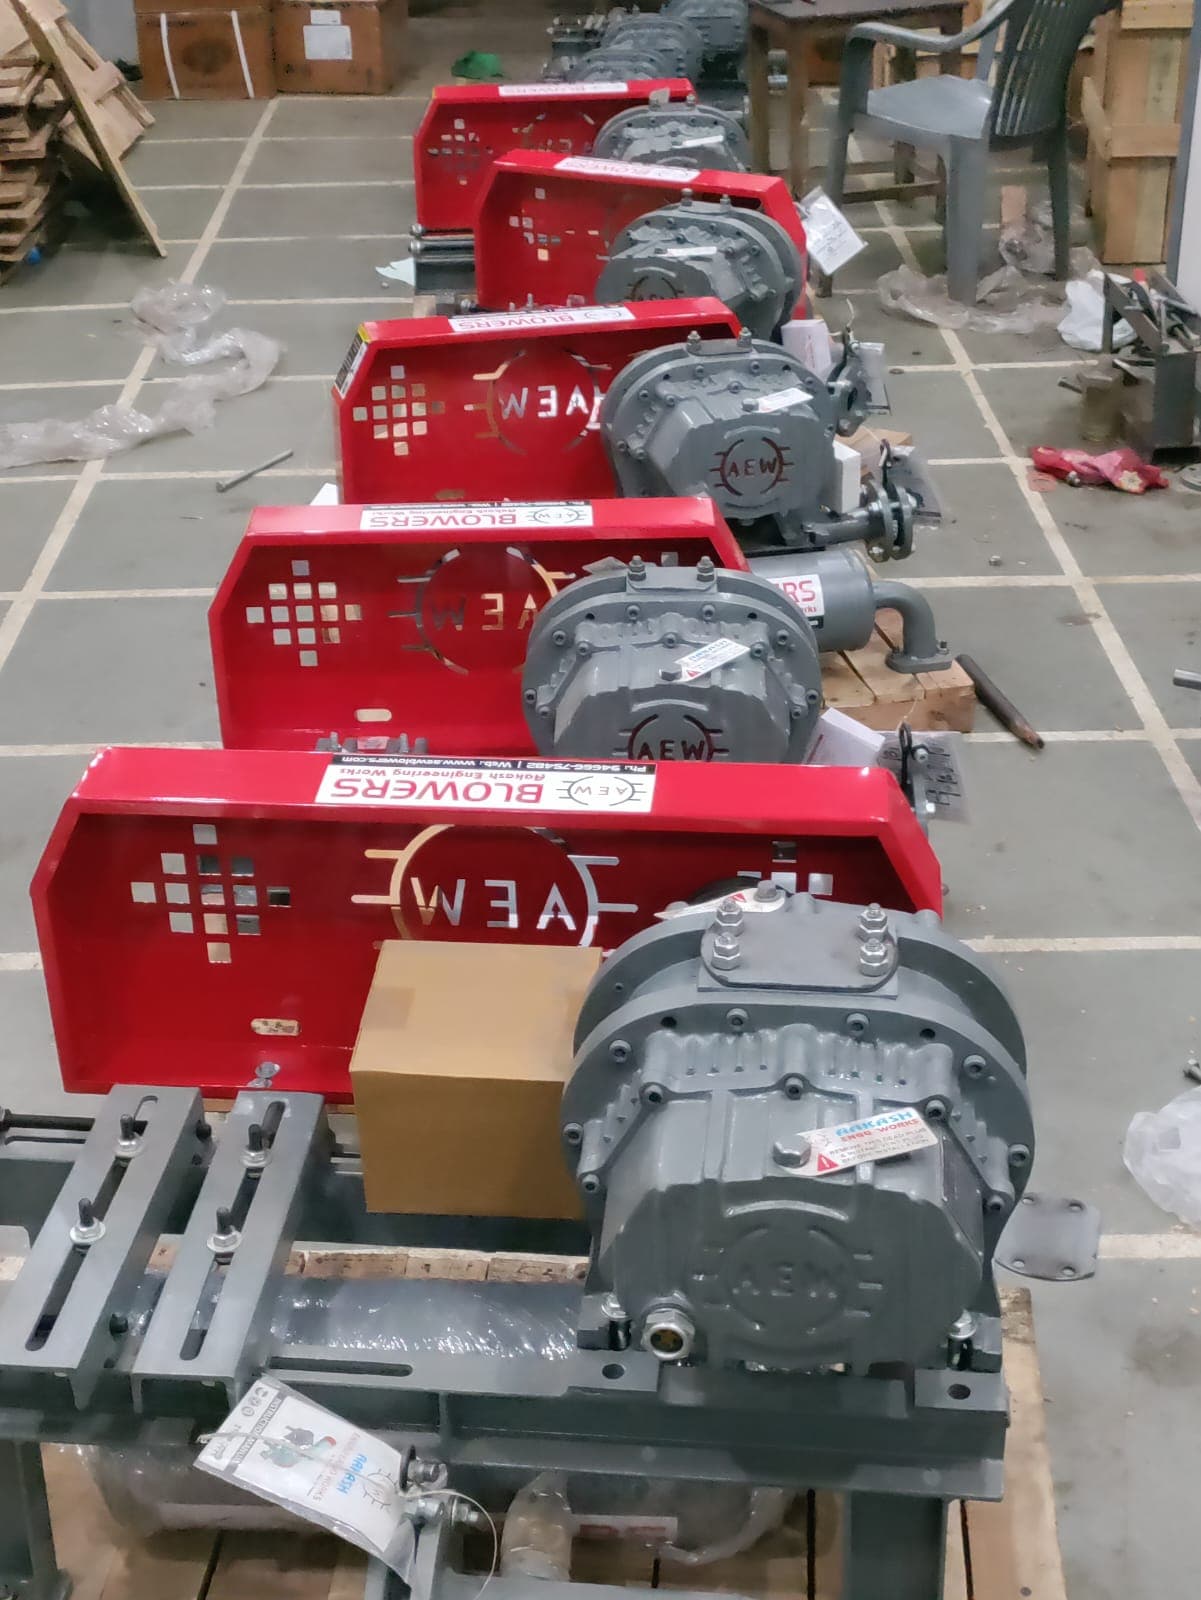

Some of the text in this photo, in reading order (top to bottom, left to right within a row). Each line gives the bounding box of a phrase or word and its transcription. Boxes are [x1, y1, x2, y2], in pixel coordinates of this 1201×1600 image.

[459, 313, 575, 330] BLOWERS
[727, 457, 778, 478] AEW
[369, 514, 517, 528] BLOWERS
[637, 740, 706, 760] AEW
[340, 768, 546, 782] Aakash Engineering Works
[331, 778, 544, 804] BLOWERS
[574, 786, 628, 796] AEW
[836, 1112, 913, 1137] AAKASH
[876, 1119, 920, 1133] WORKS
